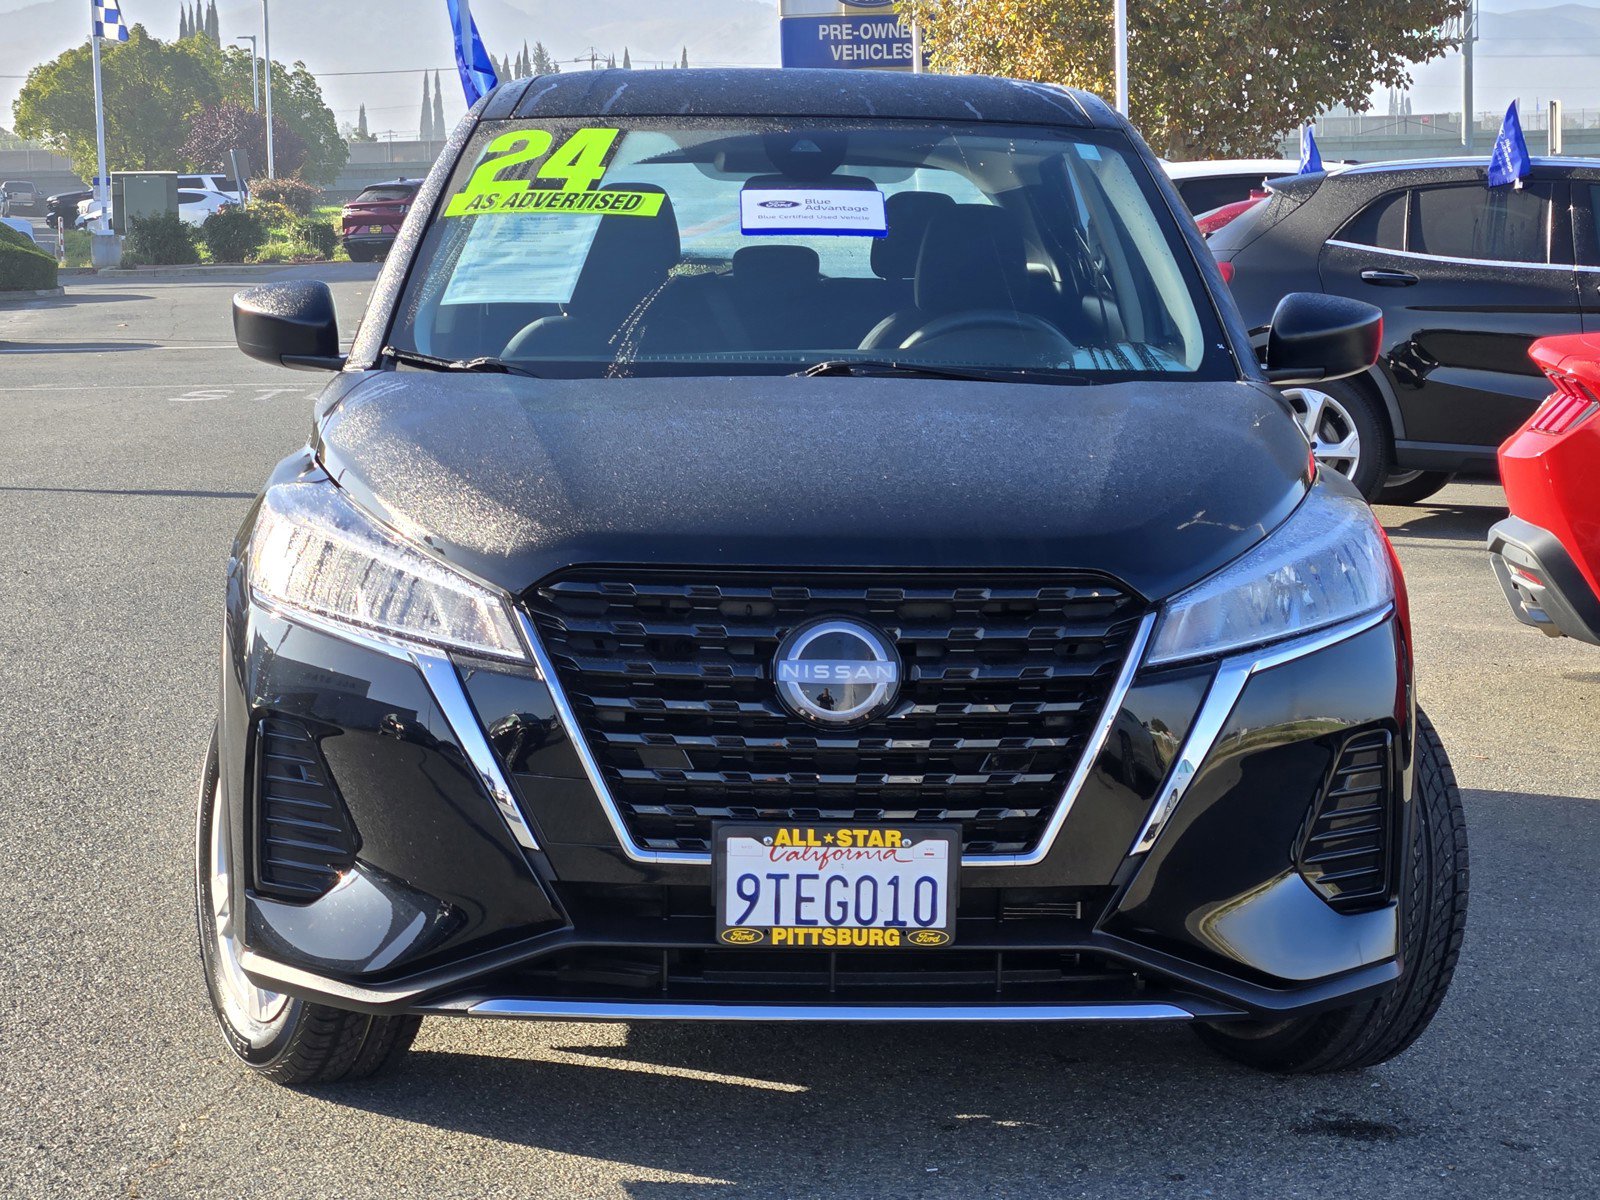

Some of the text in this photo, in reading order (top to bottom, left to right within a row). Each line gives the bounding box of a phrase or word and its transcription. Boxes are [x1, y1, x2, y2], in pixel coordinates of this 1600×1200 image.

[818, 23, 913, 40] PRE-OWNE
[831, 43, 913, 60] VEHICLES
[464, 127, 620, 193] 24
[466, 192, 645, 211] AS ADVERTISED
[804, 204, 869, 212] Advantage
[782, 663, 893, 680] NISSAN
[774, 828, 902, 848] ALL STAR
[769, 845, 913, 871] California
[736, 873, 938, 927] 9TEG010
[771, 927, 900, 946] PITTSBURG
